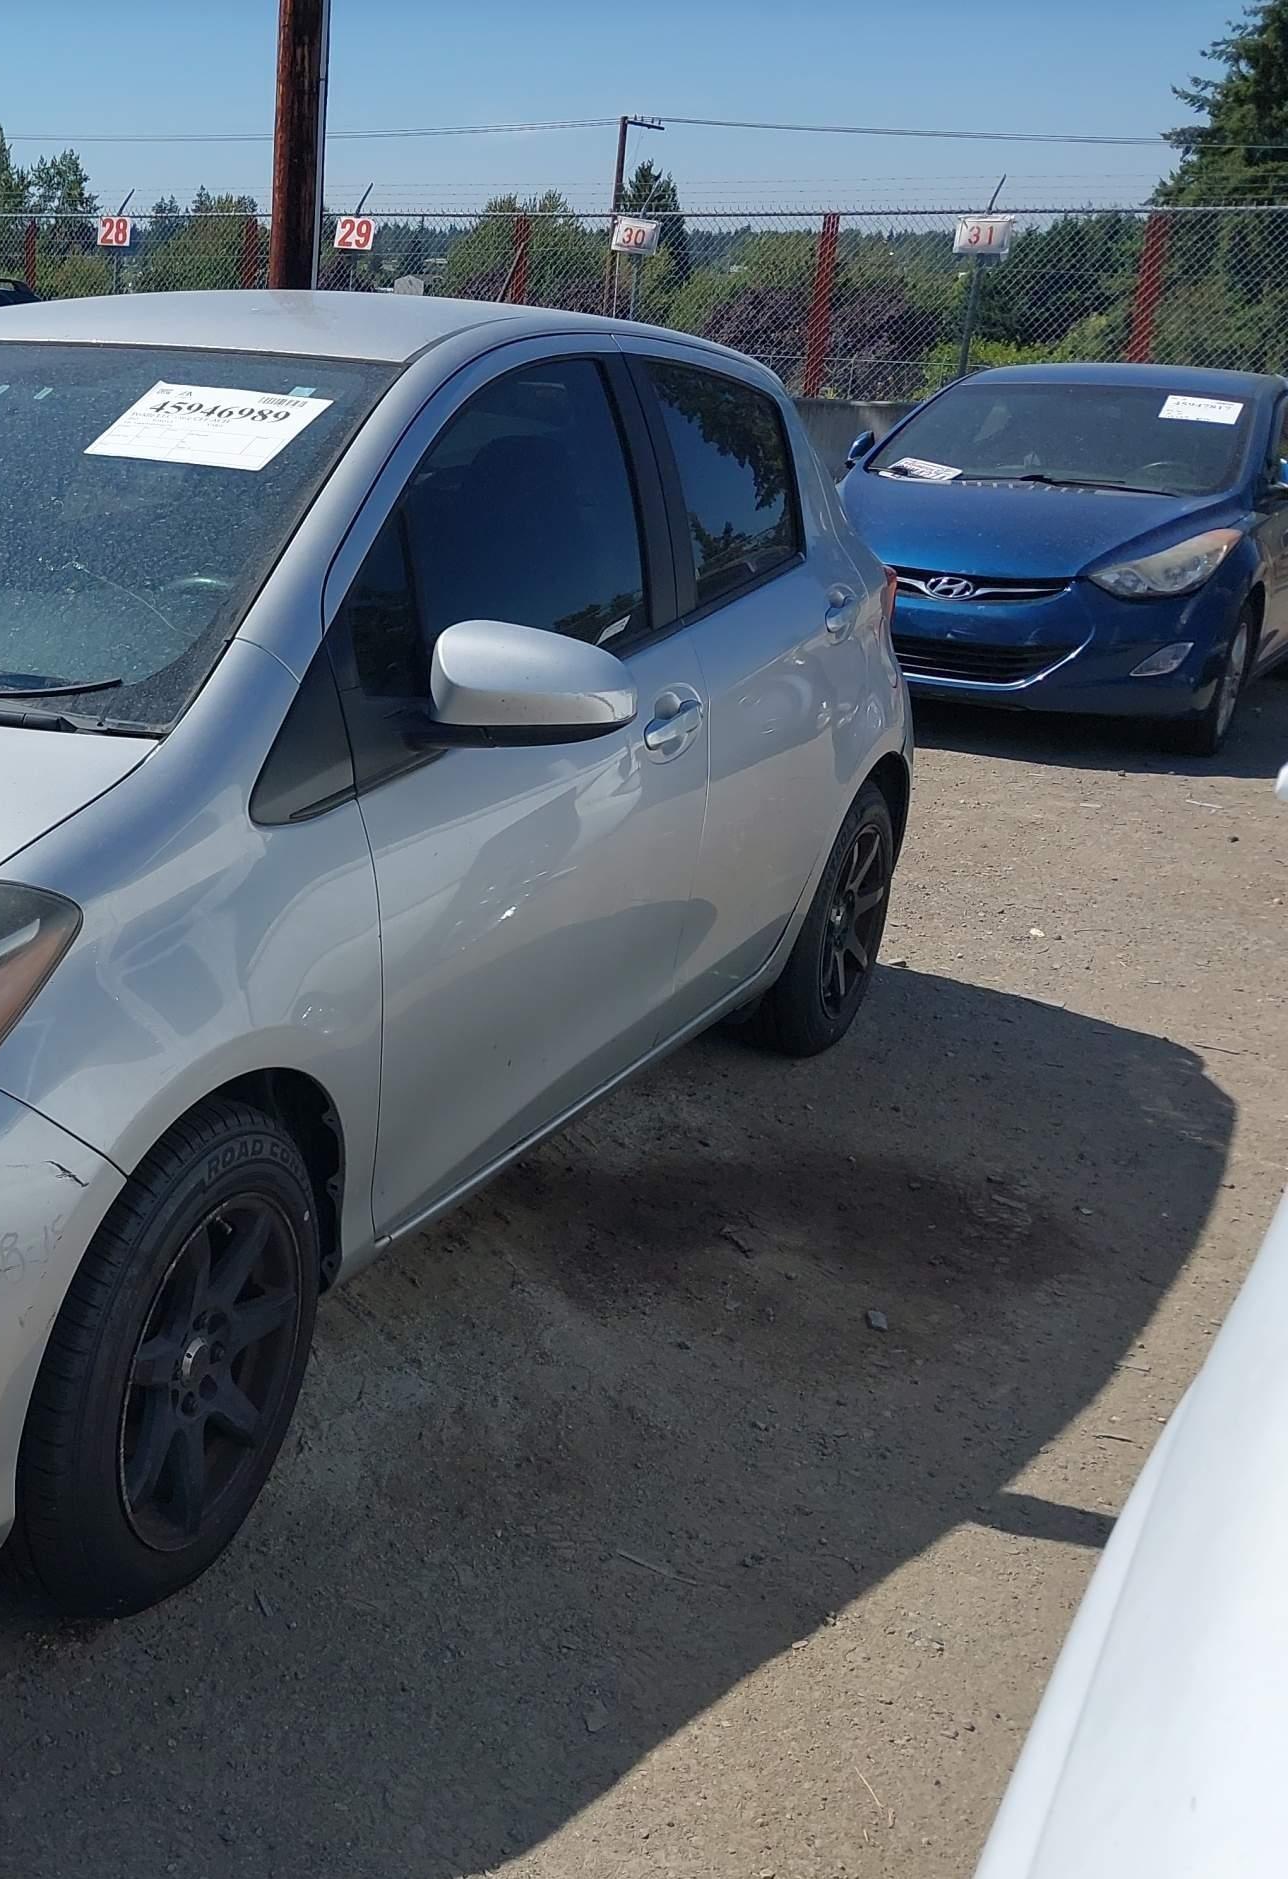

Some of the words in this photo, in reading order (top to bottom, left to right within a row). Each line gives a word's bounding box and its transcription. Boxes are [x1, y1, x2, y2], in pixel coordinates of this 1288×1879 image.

[100, 218, 128, 245] 28
[337, 219, 373, 248] 29
[622, 227, 646, 246] 30
[968, 226, 994, 246] 31
[149, 400, 291, 424] 45946989
[206, 1138, 264, 1183] ROAD
